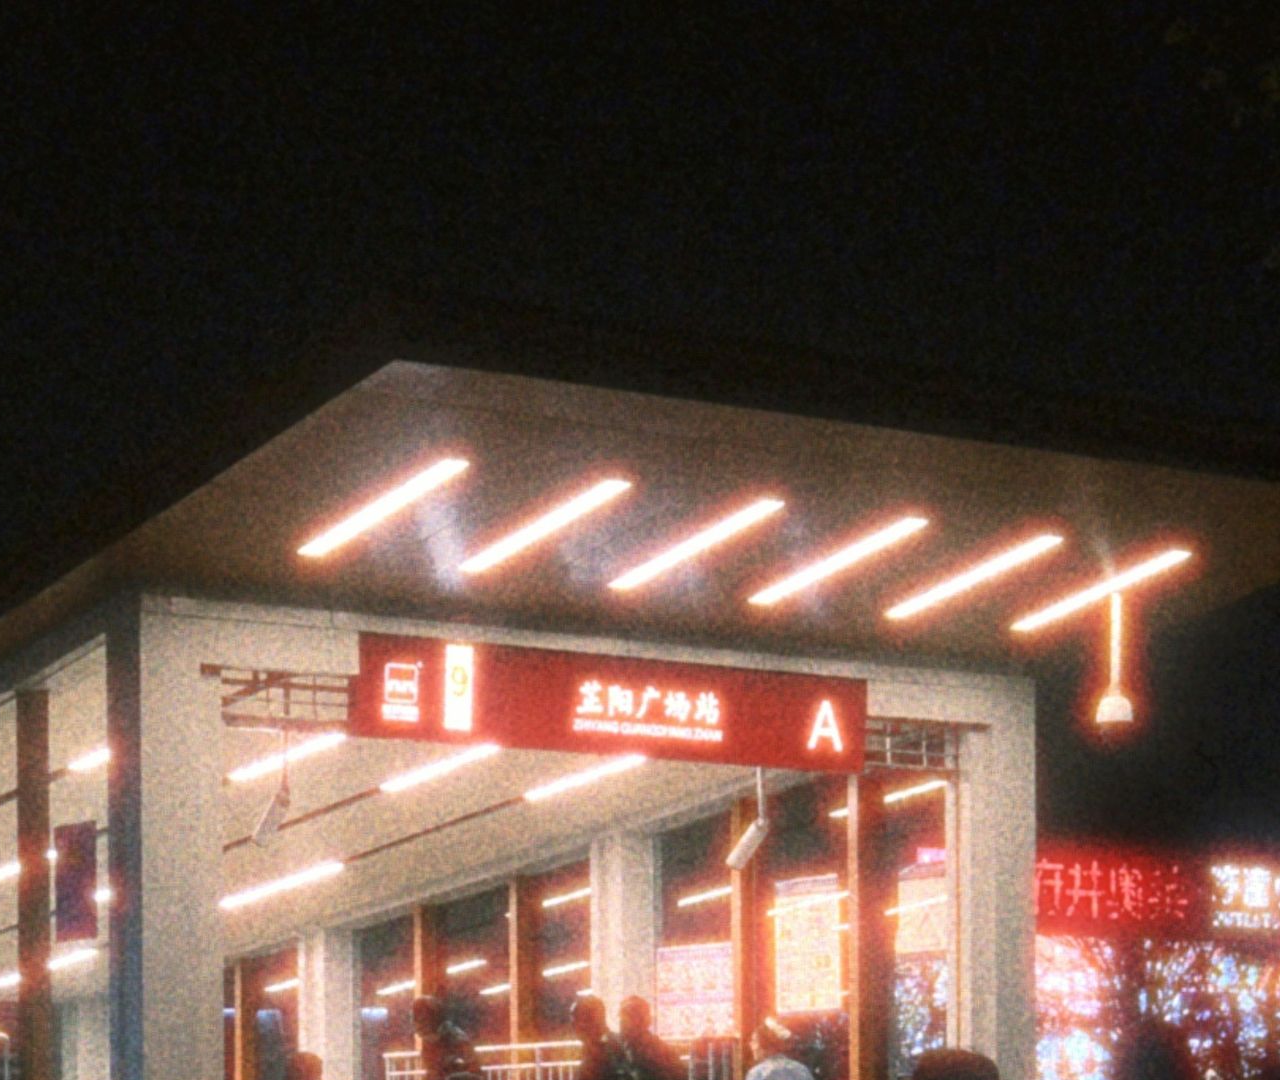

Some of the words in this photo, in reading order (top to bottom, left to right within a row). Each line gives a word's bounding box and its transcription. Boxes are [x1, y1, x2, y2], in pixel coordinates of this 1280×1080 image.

[451, 665, 468, 697] 9
[576, 680, 720, 724] 芷阳广场站
[807, 700, 843, 753] A
